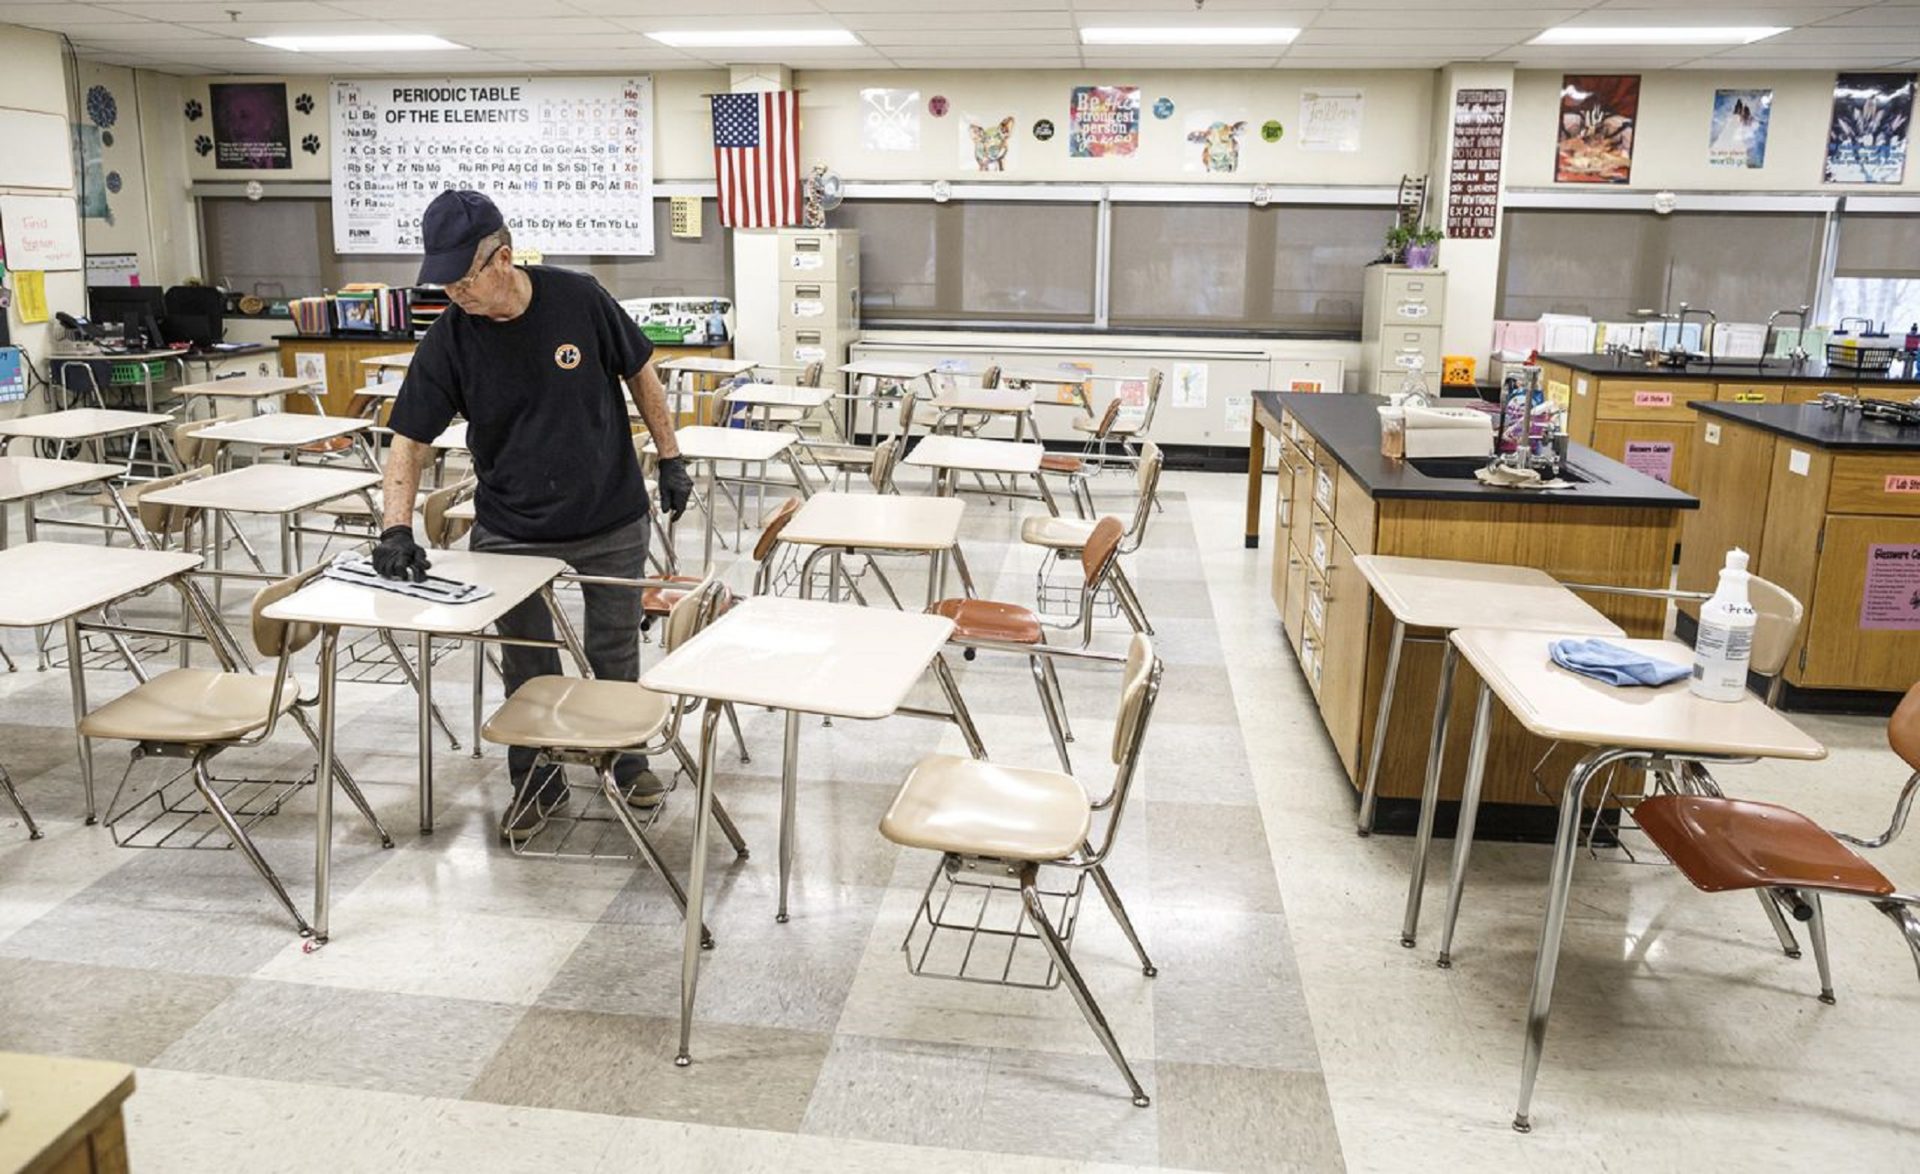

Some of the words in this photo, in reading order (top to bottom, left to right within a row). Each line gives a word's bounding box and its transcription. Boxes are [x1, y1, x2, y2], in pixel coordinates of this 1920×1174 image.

[349, 93, 356, 101] H
[624, 90, 638, 100] He
[393, 88, 466, 102] PERIODIC
[470, 87, 520, 101] TABLE
[1077, 92, 1100, 111] Be
[1104, 92, 1132, 110] the
[348, 110, 358, 120] Li
[363, 110, 376, 120] Be
[544, 109, 551, 118] B
[560, 109, 568, 118] C
[577, 109, 584, 118] N
[624, 109, 638, 118] Ne
[386, 110, 406, 123] OF
[409, 110, 439, 123] THE
[444, 109, 529, 123] ELEMENTS
[1075, 110, 1135, 124] strongest
[348, 129, 360, 137] Na
[362, 129, 377, 139] Mg
[625, 127, 637, 136] Ar
[1081, 124, 1127, 135] person
[350, 146, 357, 154] K
[363, 146, 376, 154] Ca
[379, 146, 391, 154] Sc
[398, 146, 406, 154] Ti
[413, 146, 421, 154] V
[428, 146, 438, 154] Cr
[442, 146, 457, 154] Mn
[460, 146, 472, 154] Fe
[475, 146, 488, 154] Co
[493, 145, 504, 154] Ni
[507, 145, 521, 154] Cu
[524, 145, 537, 154] Zn
[540, 145, 554, 154] Ga
[557, 145, 571, 154] Ge
[574, 145, 587, 154] As
[590, 145, 604, 154] Se
[608, 145, 619, 154] Br
[625, 145, 637, 154] Kr
[348, 164, 361, 172] Rb
[365, 164, 375, 172] Sr
[383, 164, 389, 172] Y
[396, 164, 407, 172] Zr
[411, 164, 424, 172] Nb
[426, 164, 441, 172] Mo
[458, 164, 472, 172] Ru
[475, 164, 488, 172] Rh
[491, 164, 505, 172] Pd
[508, 164, 521, 174] Ag
[524, 164, 538, 172] Cd
[543, 164, 552, 172] In
[557, 164, 570, 172] Sn
[574, 164, 587, 172] Sb
[591, 164, 604, 172] Te
[624, 164, 638, 172] Xe
[1452, 172, 1480, 181] DREAM
[1485, 172, 1498, 181] BIG
[348, 181, 361, 190] Cs
[364, 181, 377, 190] Ba
[397, 181, 407, 190] Hf
[413, 181, 424, 190] Ta
[429, 181, 438, 190] W
[444, 181, 457, 190] Re
[459, 181, 472, 190] Os
[478, 181, 486, 190] Ir
[493, 181, 504, 190] Pt
[508, 181, 521, 190] Au
[524, 181, 538, 191] Hg
[544, 181, 552, 190] Tl
[557, 181, 570, 190] Pb
[576, 181, 586, 190] Bi
[590, 181, 604, 190] Po
[609, 181, 620, 190] At
[624, 181, 638, 190] Rn
[350, 199, 360, 207] Fr
[365, 199, 378, 207] Ra
[1450, 206, 1496, 216] EXPLORE
[397, 219, 410, 227] La
[508, 220, 523, 228] Gd
[526, 220, 539, 228] Tb
[542, 220, 555, 230] Dy
[558, 220, 572, 228] Ho
[576, 220, 587, 228] Er
[591, 220, 606, 228] Tm
[608, 220, 622, 228] Yb
[625, 220, 638, 228] Lu
[1448, 228, 1494, 238] LISTEN
[398, 237, 411, 245] Ac
[1874, 548, 1909, 560] Glassware
